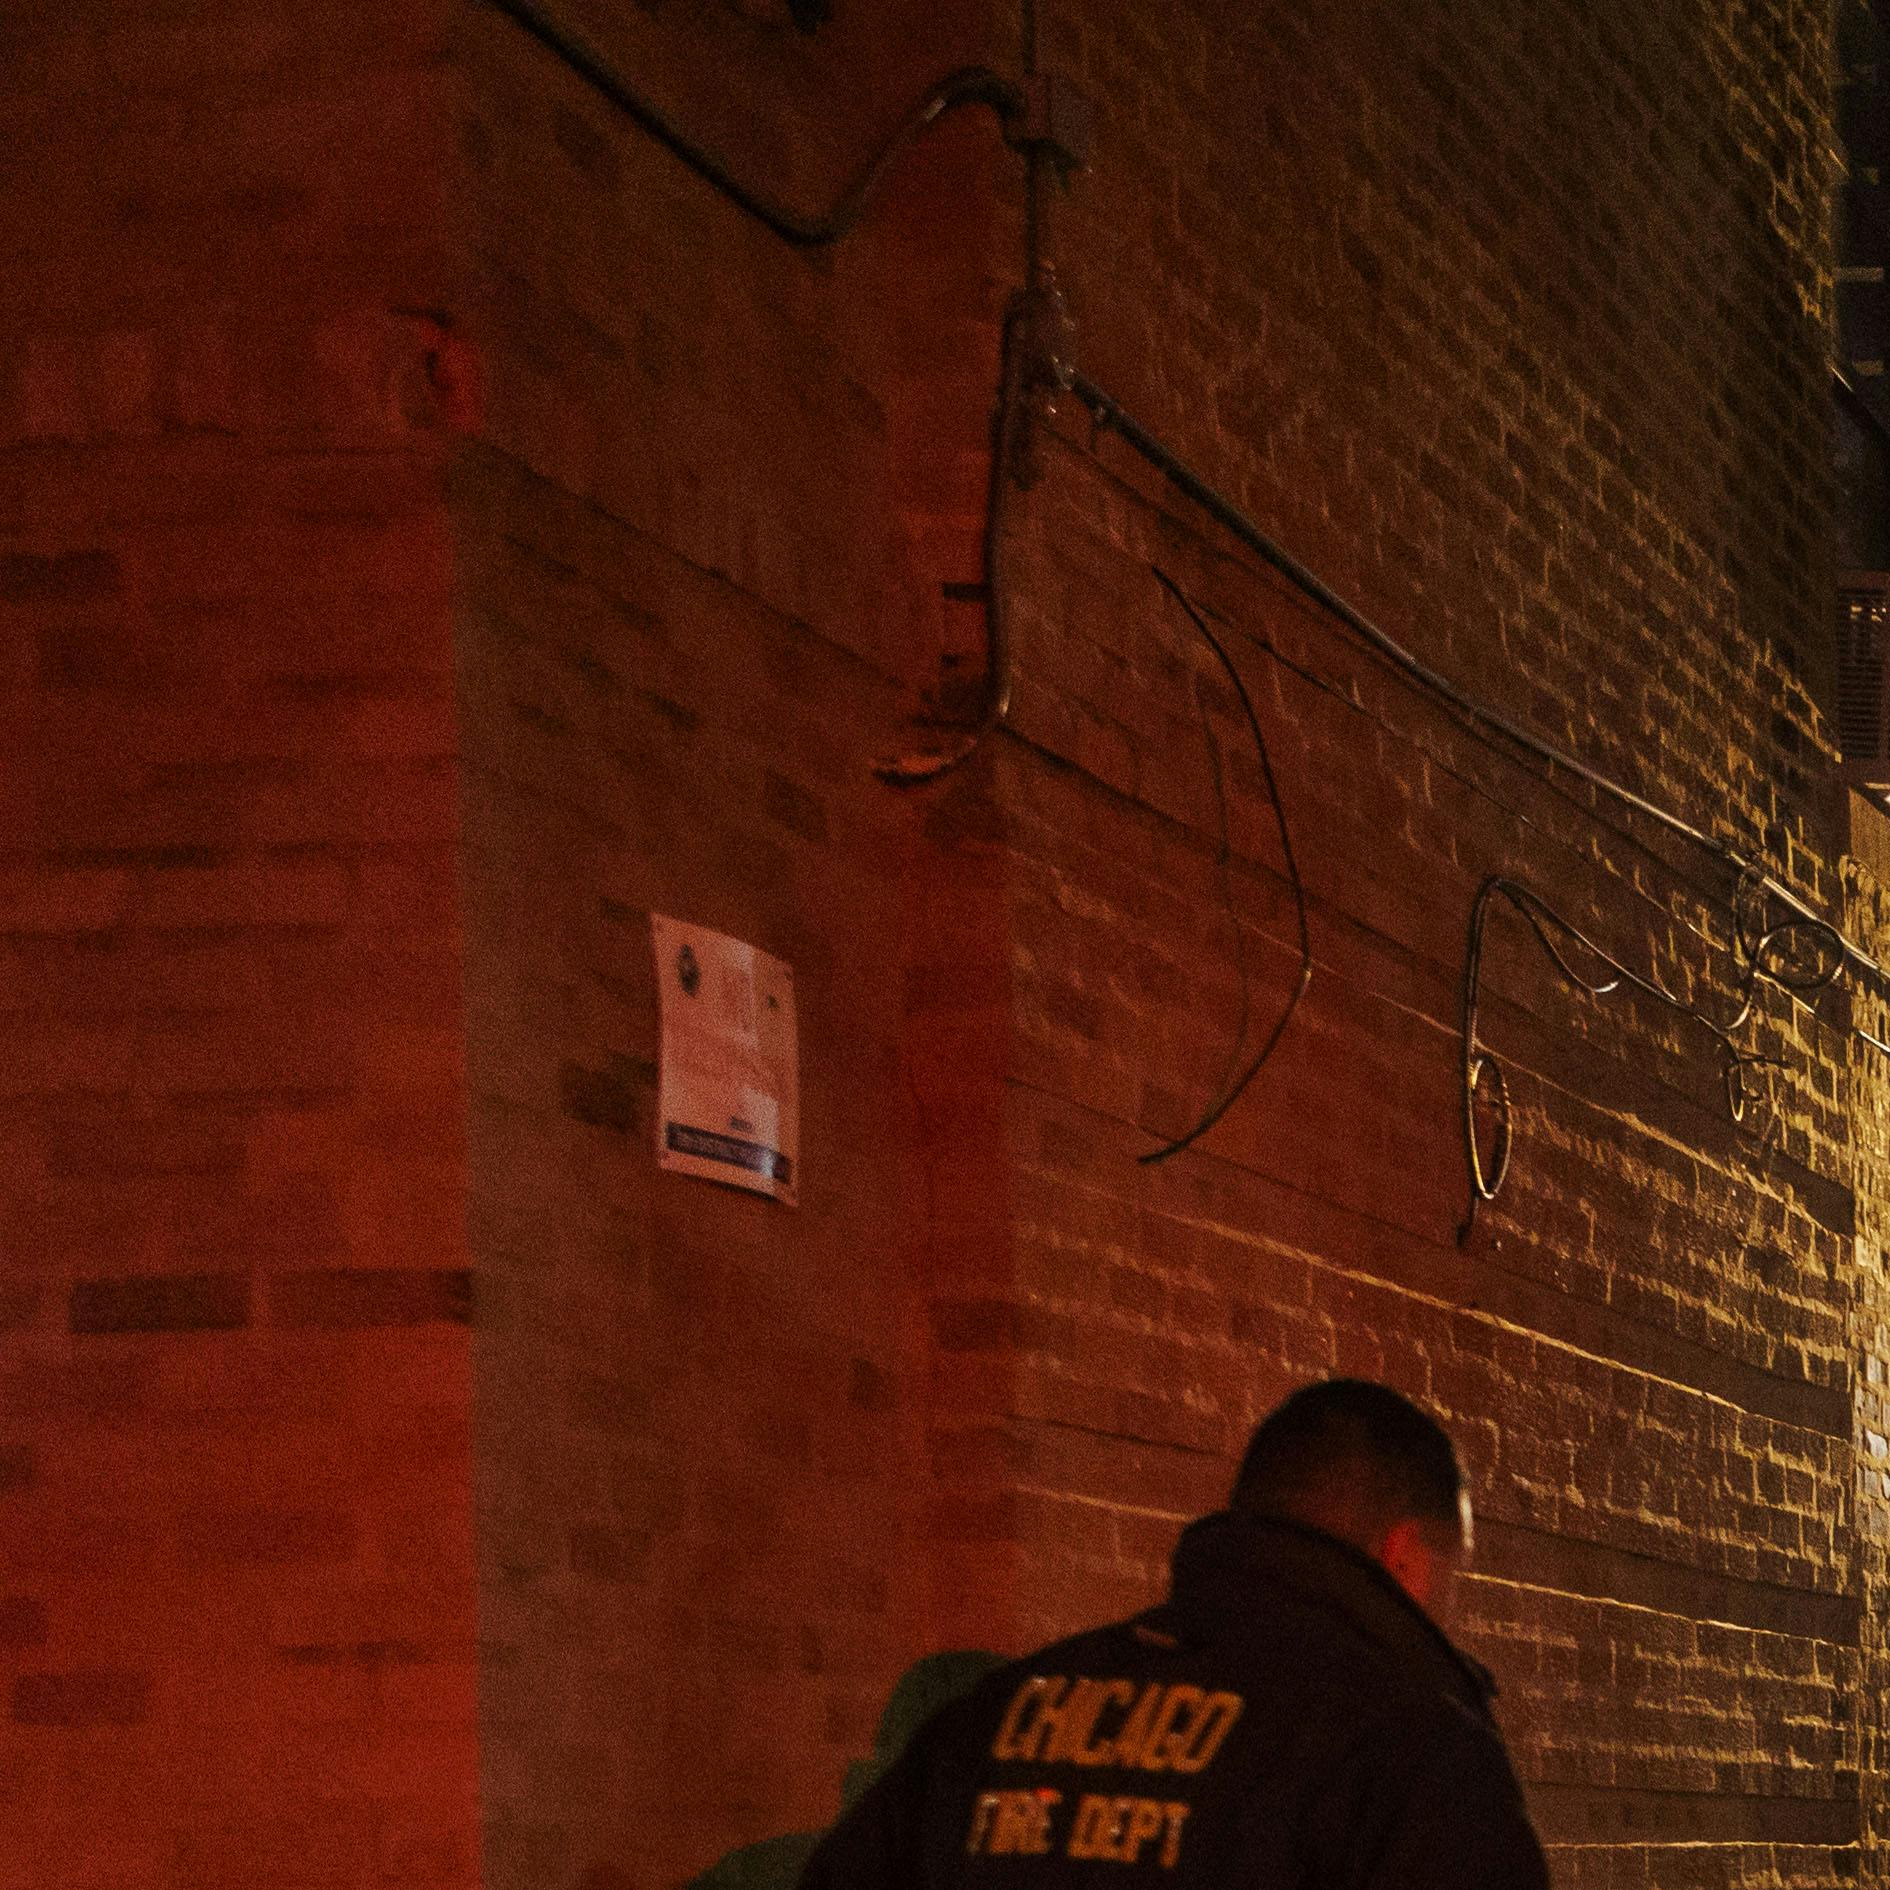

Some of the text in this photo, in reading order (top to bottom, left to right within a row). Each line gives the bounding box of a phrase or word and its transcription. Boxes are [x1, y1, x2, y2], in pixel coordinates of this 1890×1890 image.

[992, 1674, 1244, 1774] CHICAGO
[968, 1787, 1191, 1870] FIRE DEPT
